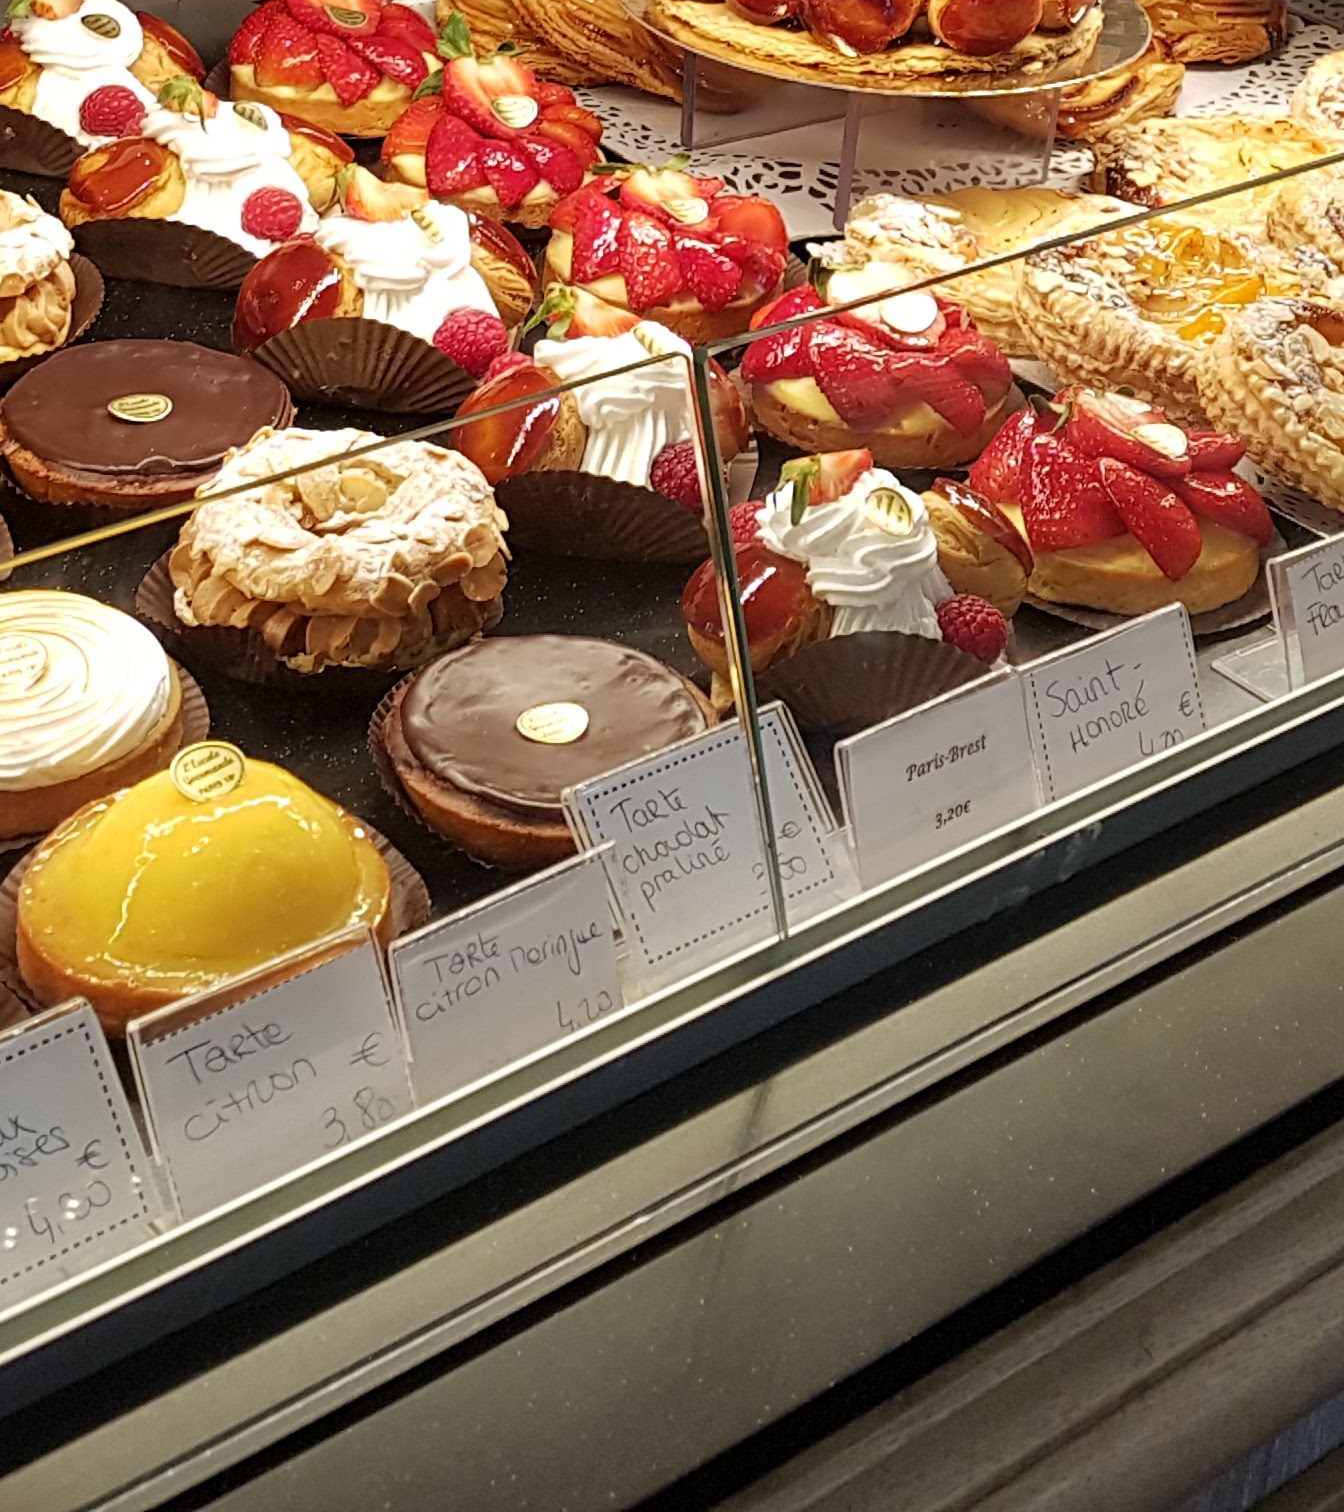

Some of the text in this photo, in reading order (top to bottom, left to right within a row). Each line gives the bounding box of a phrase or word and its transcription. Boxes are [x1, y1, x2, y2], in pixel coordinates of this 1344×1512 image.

[1178, 690, 1194, 717] €
[905, 734, 987, 782] Paris-Brest
[934, 800, 972, 830] 3,20€
[348, 1031, 392, 1068] €
[75, 1138, 111, 1170] €
